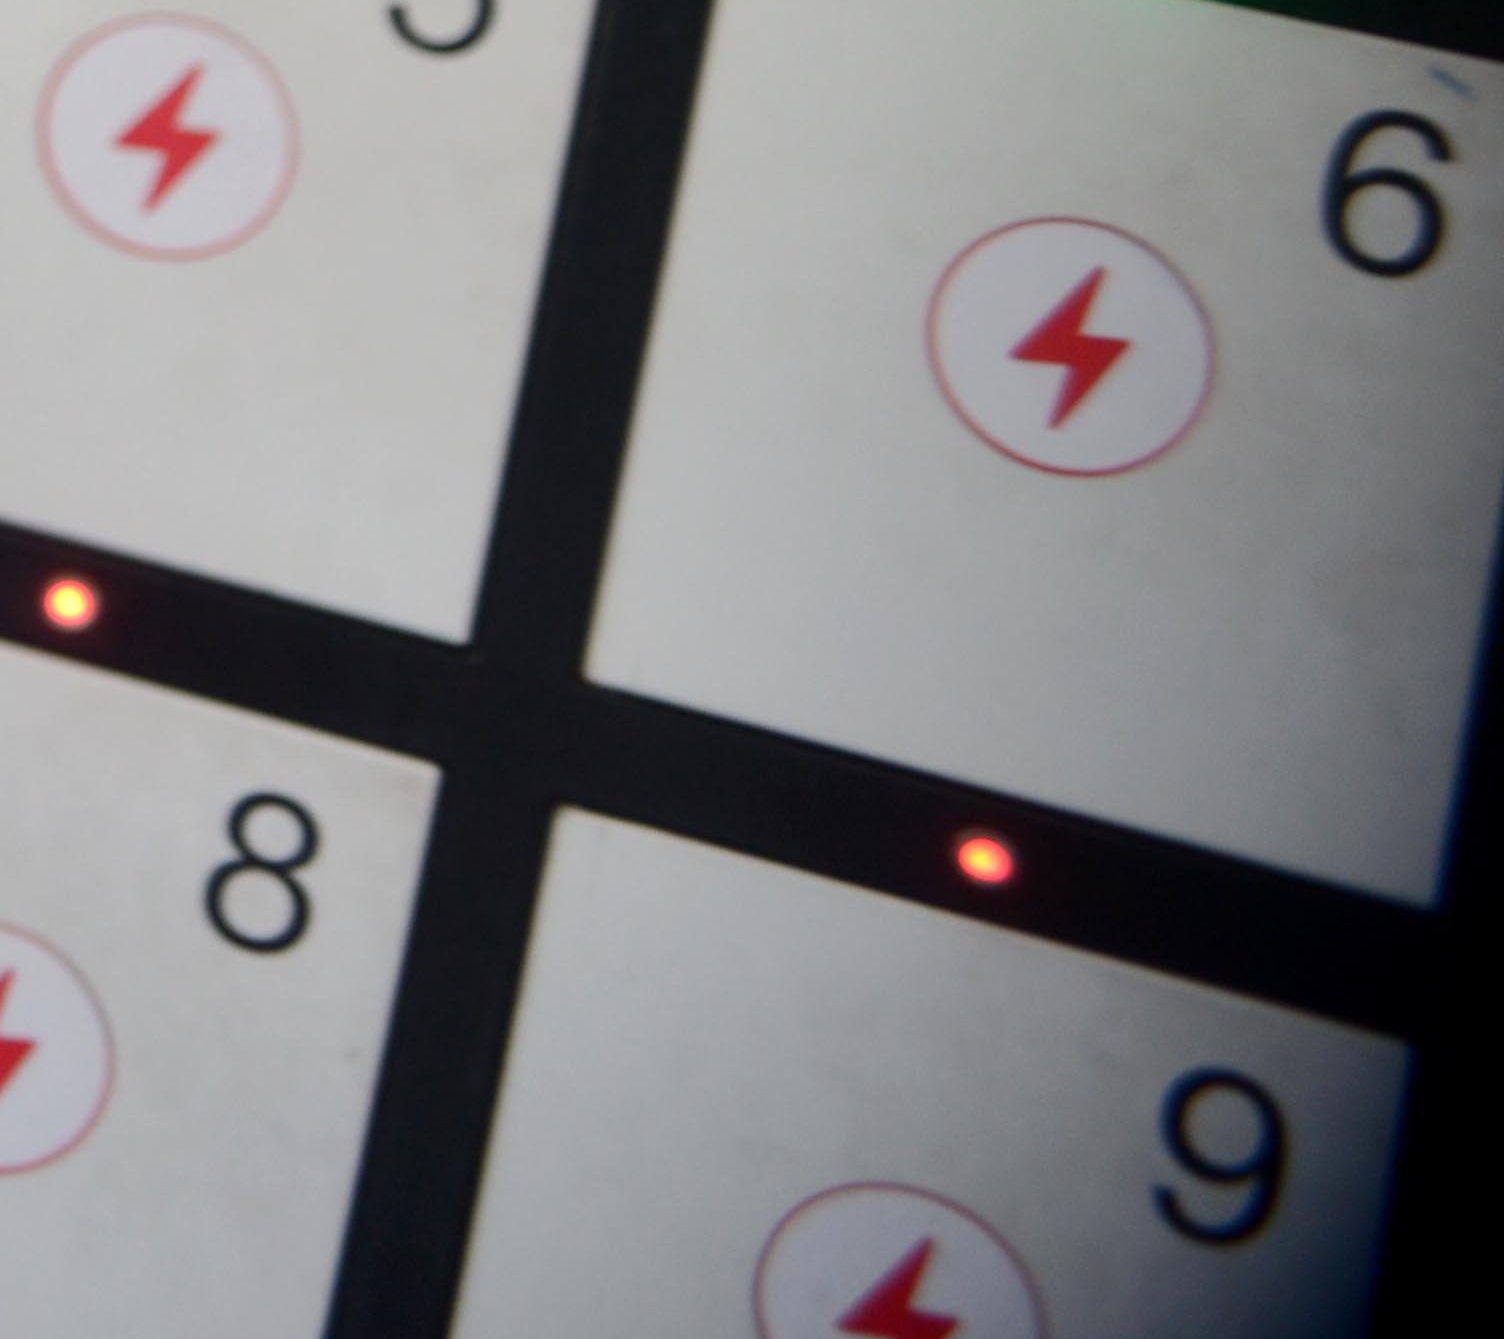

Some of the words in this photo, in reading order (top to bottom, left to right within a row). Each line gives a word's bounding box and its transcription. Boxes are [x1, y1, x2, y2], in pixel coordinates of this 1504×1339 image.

[1322, 108, 1458, 280] 6
[203, 790, 319, 954] 8
[1151, 1064, 1289, 1249] 9
